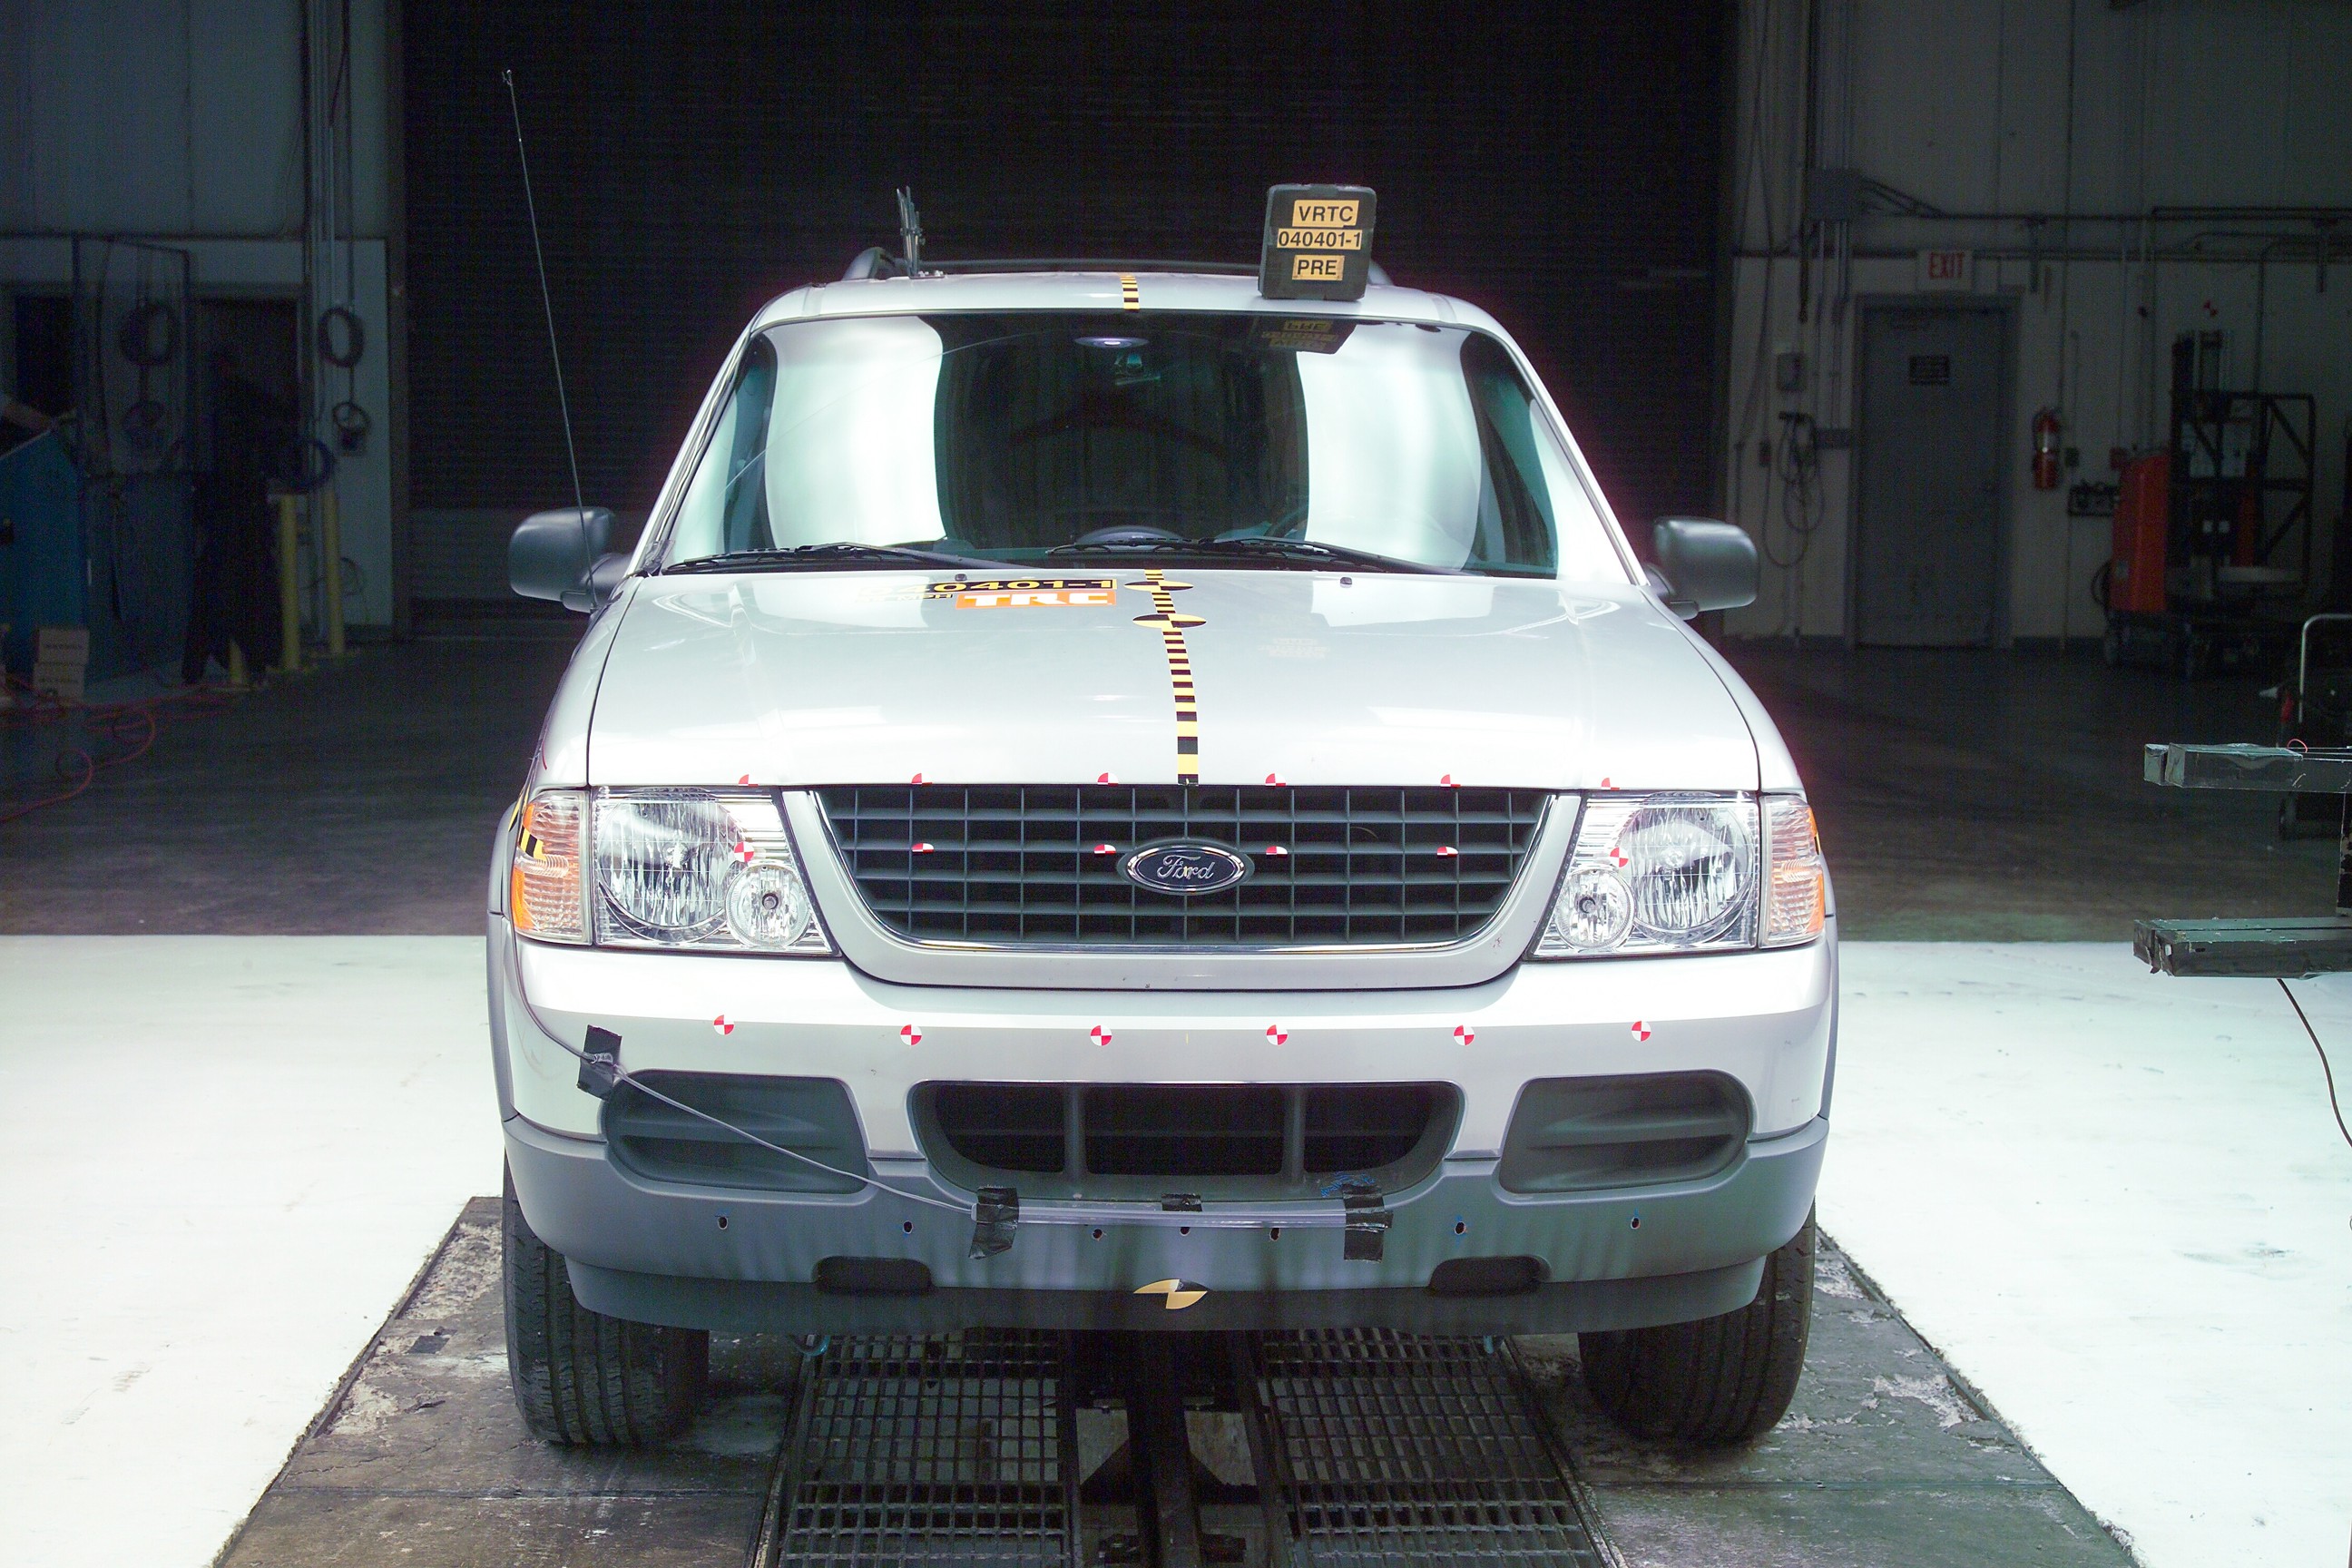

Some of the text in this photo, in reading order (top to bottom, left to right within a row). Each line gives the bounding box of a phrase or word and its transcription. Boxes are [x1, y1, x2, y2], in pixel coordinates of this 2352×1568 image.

[1298, 206, 1354, 222] VRTC
[1279, 231, 1361, 248] 040401-1
[1297, 260, 1338, 276] PRE
[1927, 251, 1965, 279] EXIT
[964, 592, 1109, 606] TRC
[1156, 854, 1215, 880] Ford
